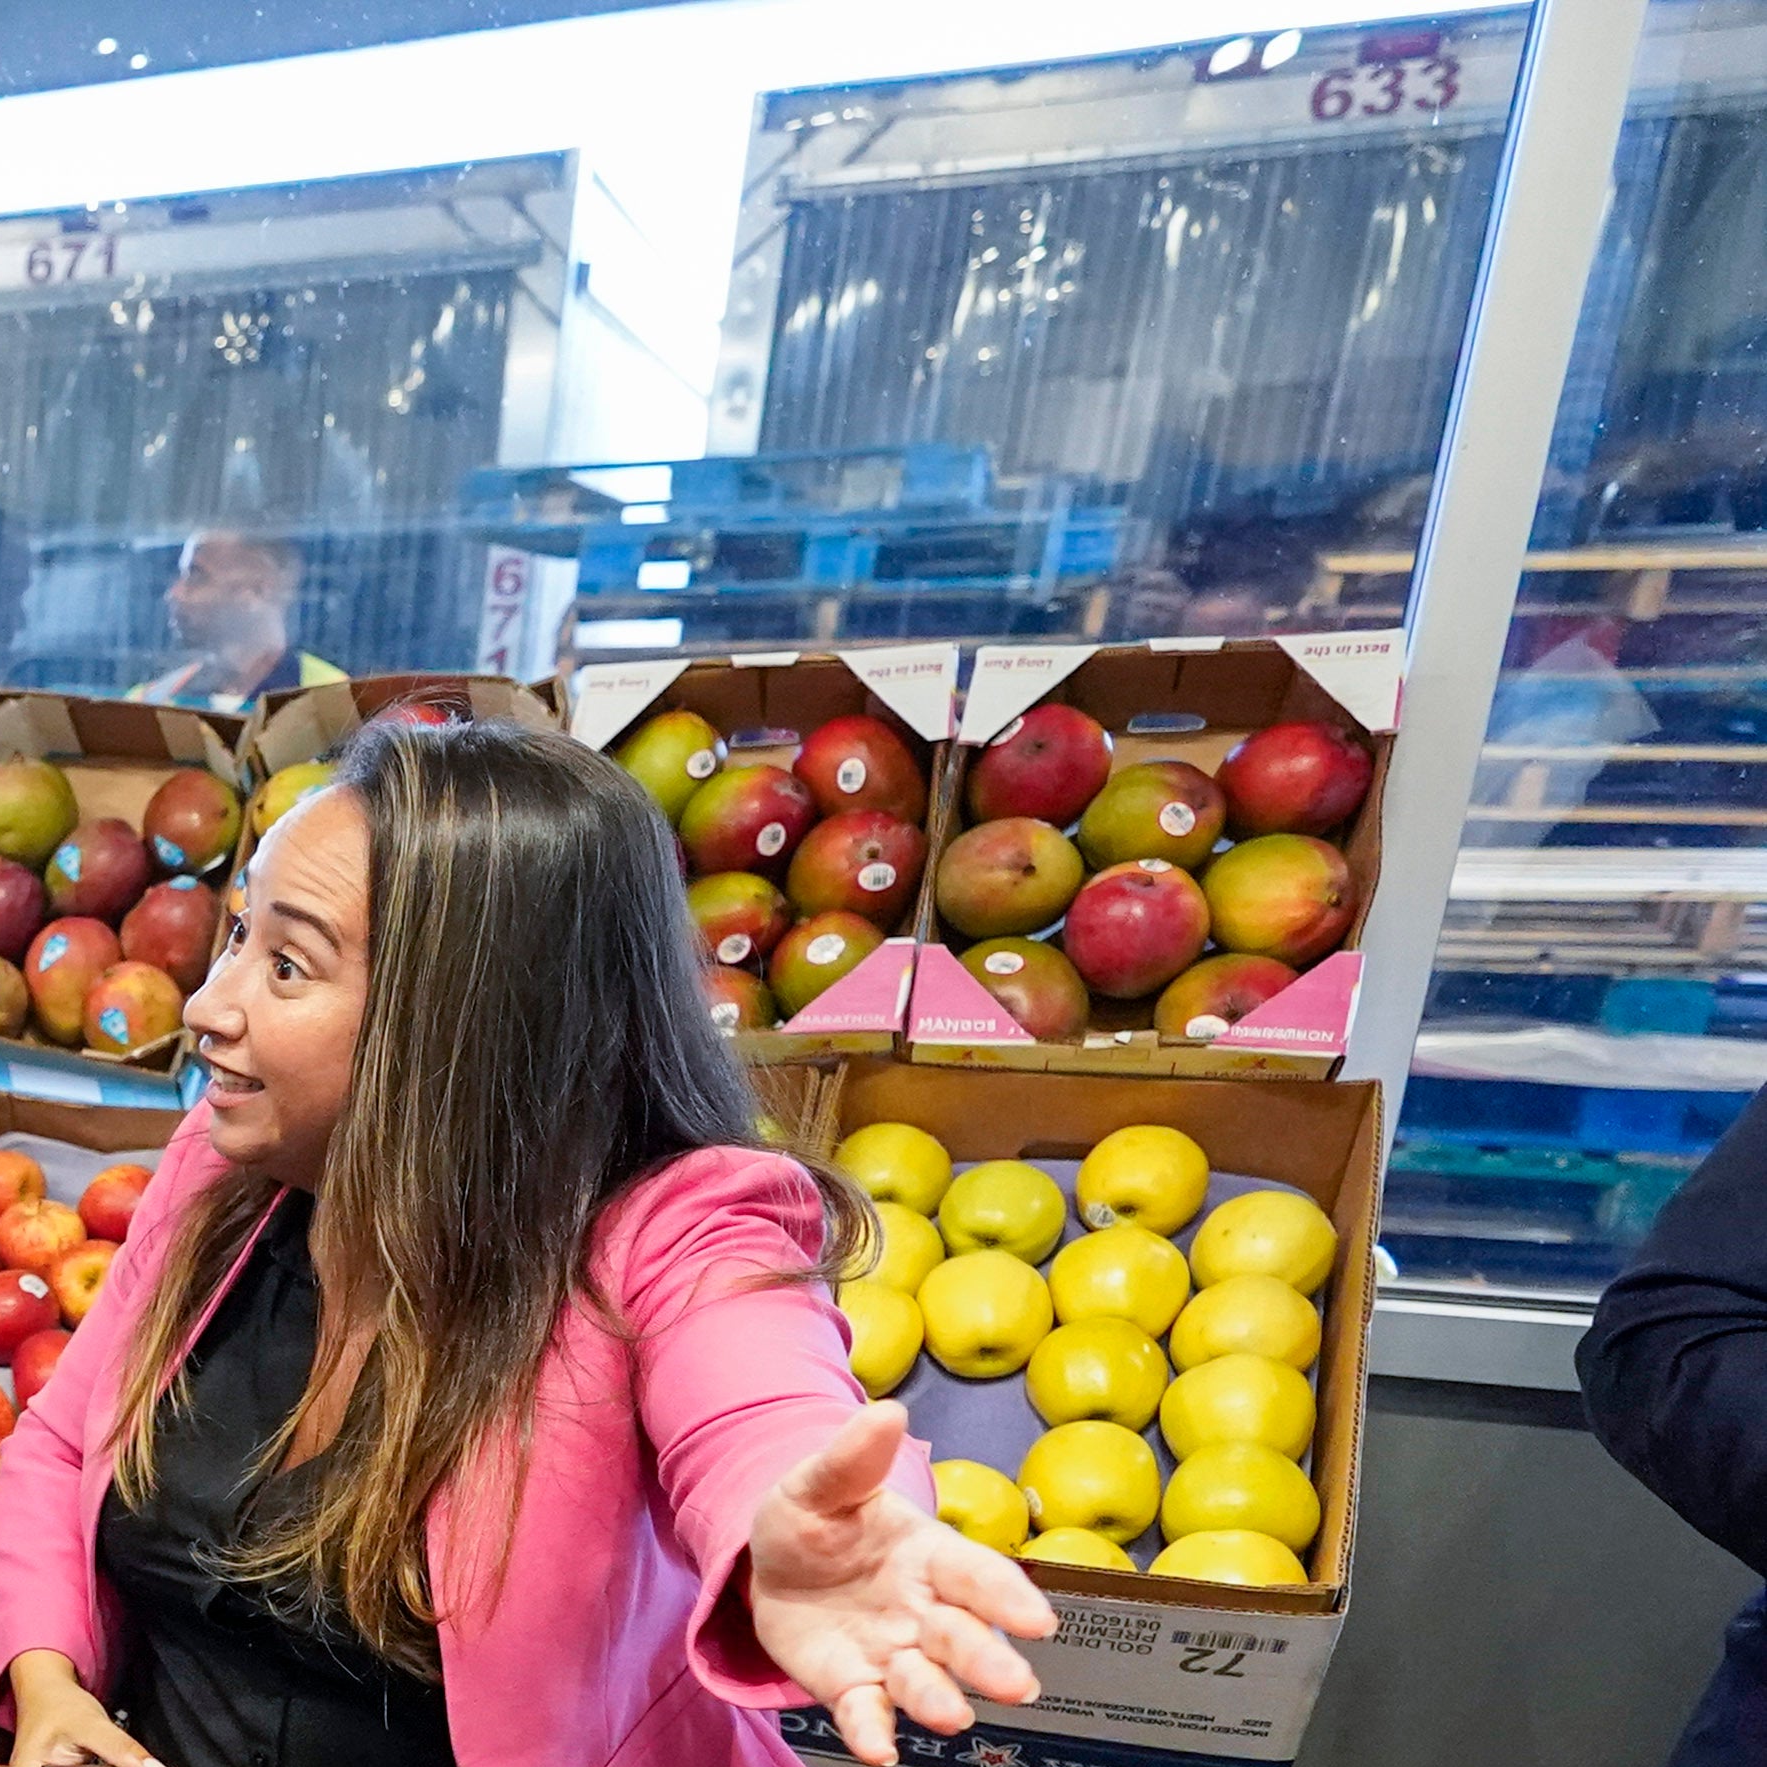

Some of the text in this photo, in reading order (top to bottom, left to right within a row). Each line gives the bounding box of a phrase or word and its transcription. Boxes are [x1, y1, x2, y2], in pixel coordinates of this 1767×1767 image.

[1312, 55, 1460, 120] 633
[28, 235, 115, 283] 671
[1052, 1633, 1154, 1656] GOLDEN
[1179, 1646, 1247, 1678] 72
[1177, 1720, 1208, 1733] FOR
[1211, 1725, 1269, 1738] PACKED
